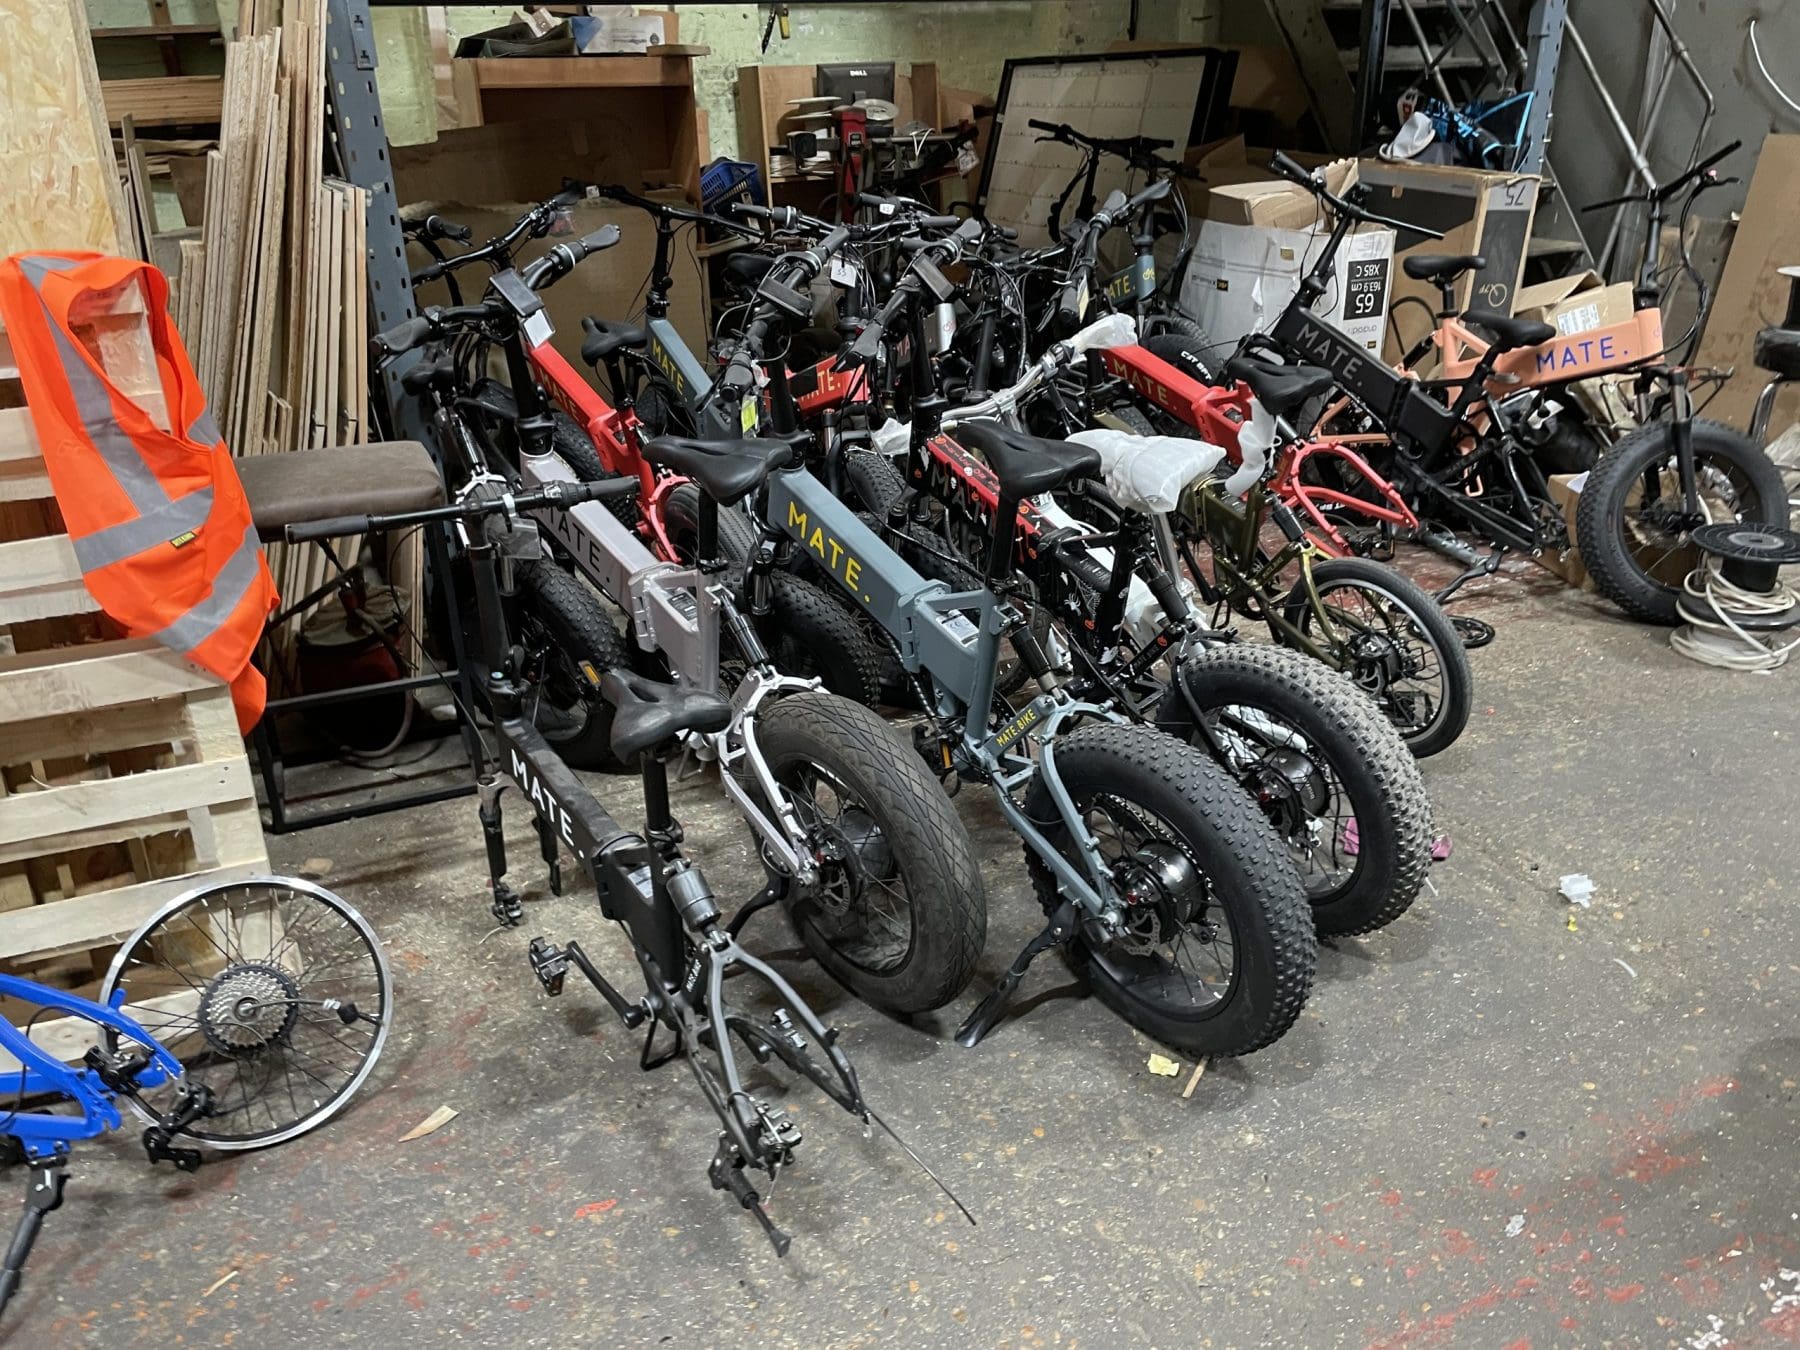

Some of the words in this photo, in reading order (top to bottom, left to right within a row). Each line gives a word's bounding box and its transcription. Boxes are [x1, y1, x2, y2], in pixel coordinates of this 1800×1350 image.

[849, 69, 868, 77] DELL
[1504, 184, 1526, 206] 75
[1107, 274, 1136, 299] ATE.
[1355, 293, 1375, 314] 65
[1296, 322, 1363, 387] MATE.
[1535, 336, 1628, 373] MATE.
[1113, 357, 1177, 411] MATE.
[788, 501, 870, 603] MATE.
[511, 747, 585, 860] MATE.
